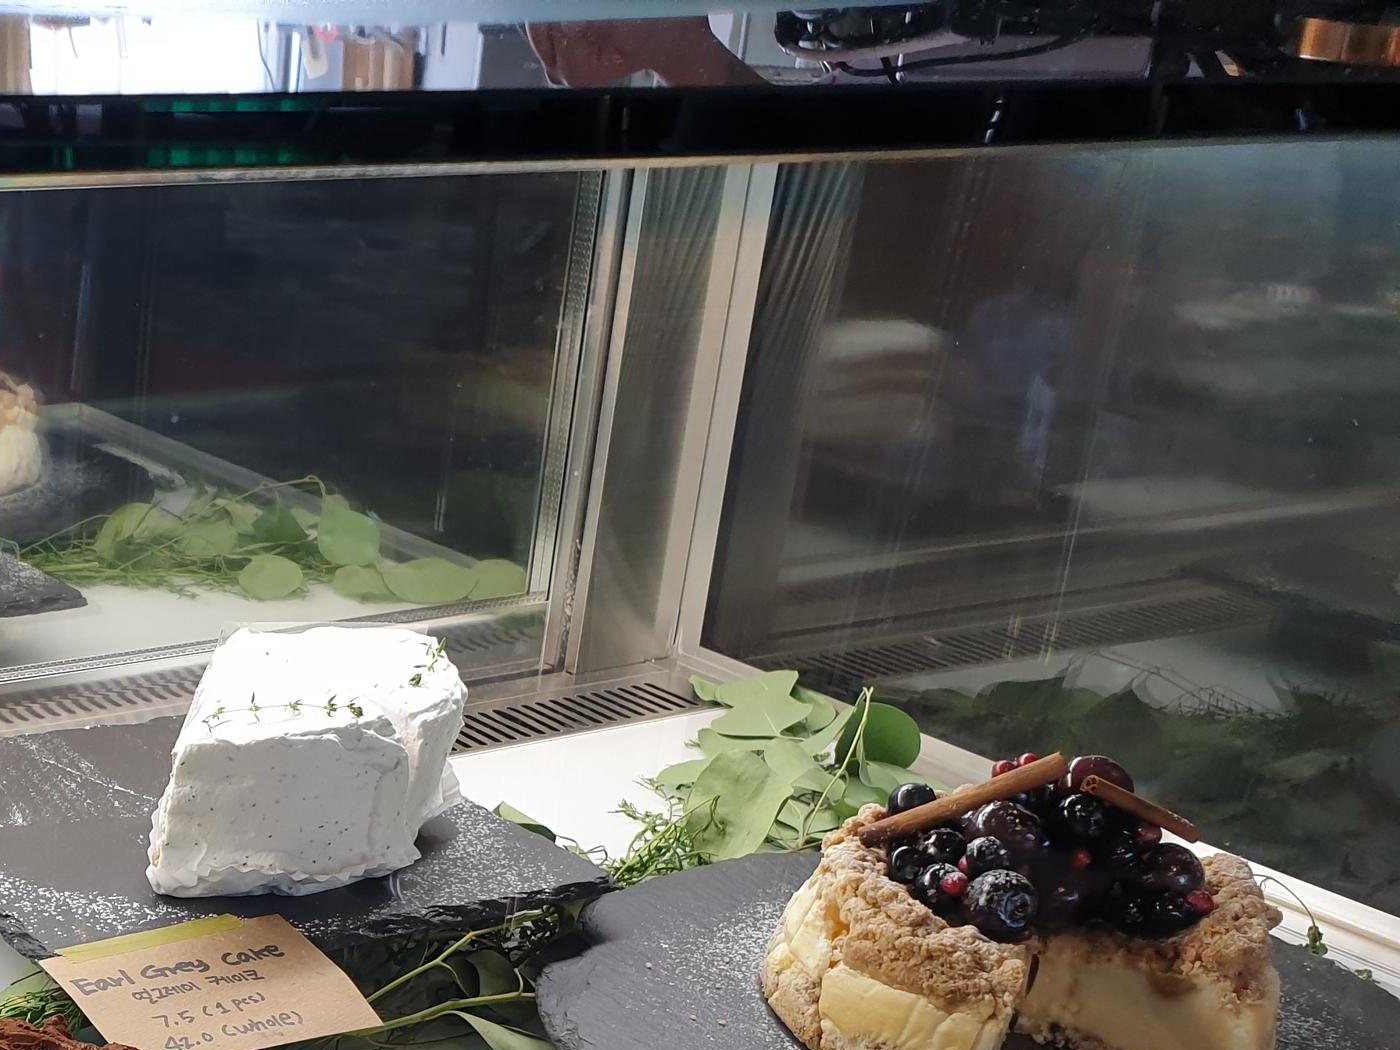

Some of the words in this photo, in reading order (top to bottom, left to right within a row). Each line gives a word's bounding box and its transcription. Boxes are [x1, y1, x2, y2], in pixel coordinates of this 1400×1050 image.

[69, 968, 136, 997] Earl
[140, 958, 211, 981] Grey
[151, 1010, 196, 1028] 7.5
[221, 1010, 304, 1038] (whole)
